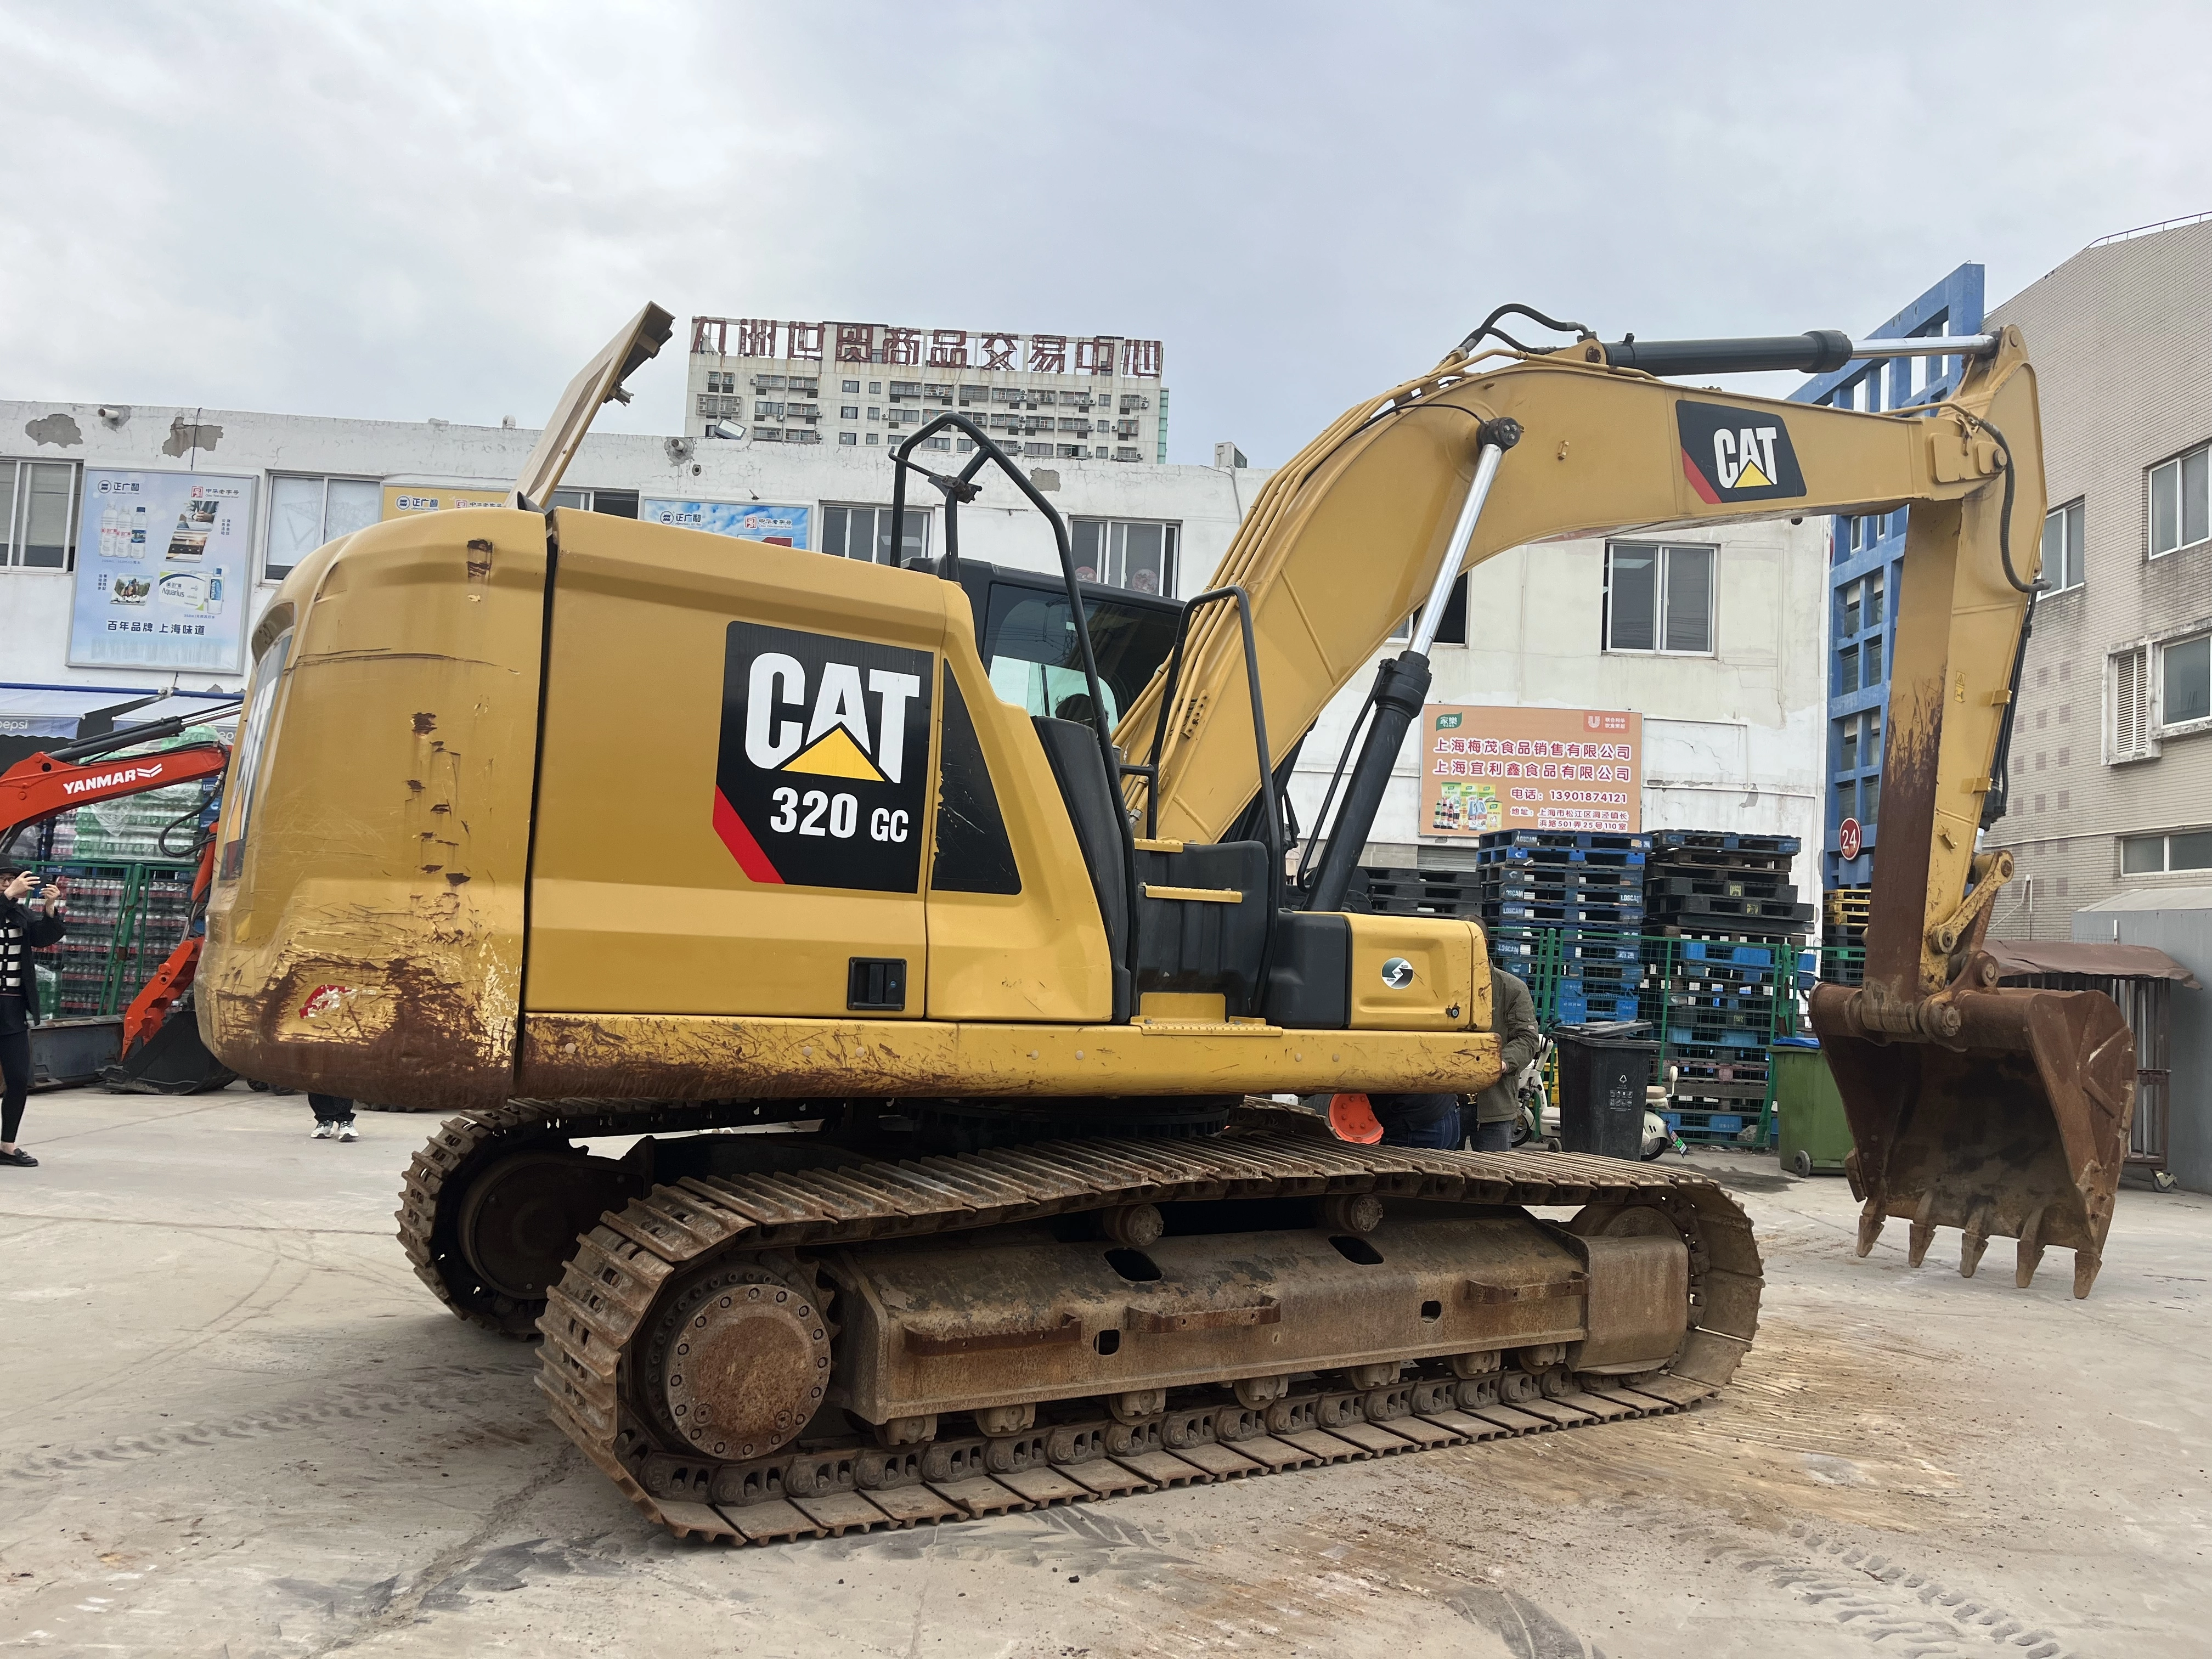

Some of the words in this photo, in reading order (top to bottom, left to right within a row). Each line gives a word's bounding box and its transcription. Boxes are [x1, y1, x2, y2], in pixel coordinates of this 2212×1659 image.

[1713, 427, 1778, 488] CAT
[114, 482, 139, 492] 正广和
[413, 498, 438, 507] 正广和
[676, 514, 701, 522] 正广和
[162, 588, 185, 597] Aquarius
[108, 620, 153, 633] 百年品牌
[159, 623, 205, 635] 上海味道
[744, 652, 920, 784] CAT
[1434, 738, 1630, 760] 上海梅茂食品销售有限公司
[1434, 760, 1629, 781] 上海宜利鑫食品有限公司
[63, 769, 136, 794] YANMAR
[1550, 791, 1626, 803] 13901874121
[770, 787, 858, 838] 320
[870, 808, 909, 843] GC
[1842, 828, 1857, 850] 24
